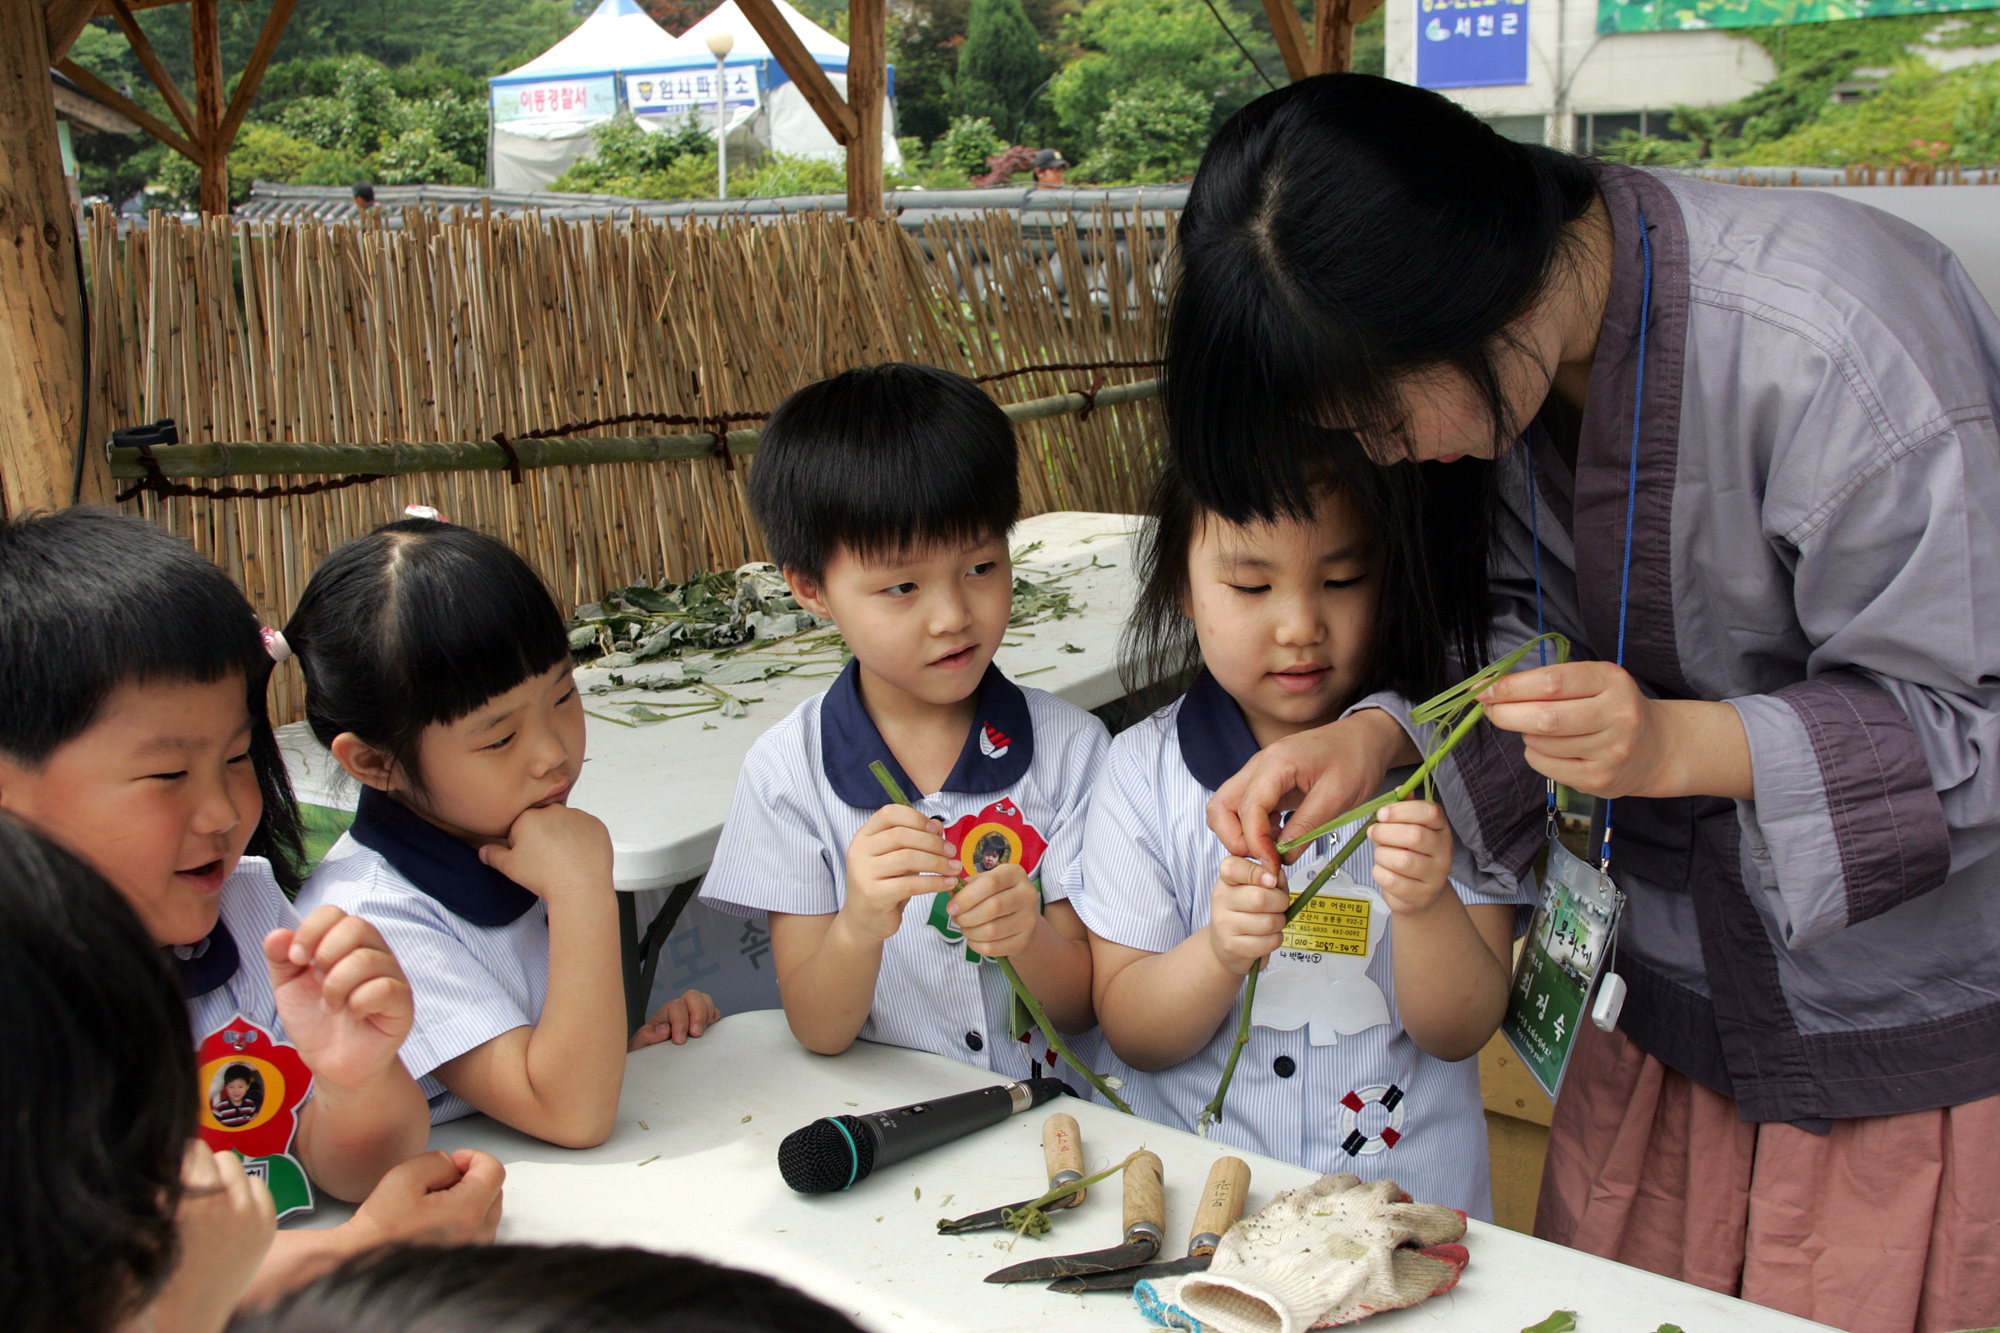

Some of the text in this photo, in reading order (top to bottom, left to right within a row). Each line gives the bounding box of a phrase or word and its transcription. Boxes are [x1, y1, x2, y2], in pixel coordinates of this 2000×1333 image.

[1454, 12, 1519, 38] 서천군
[520, 86, 588, 113] 이동경찰서
[1310, 900, 1363, 913] 문화 어린이집
[1332, 929, 1360, 937] 462-0092
